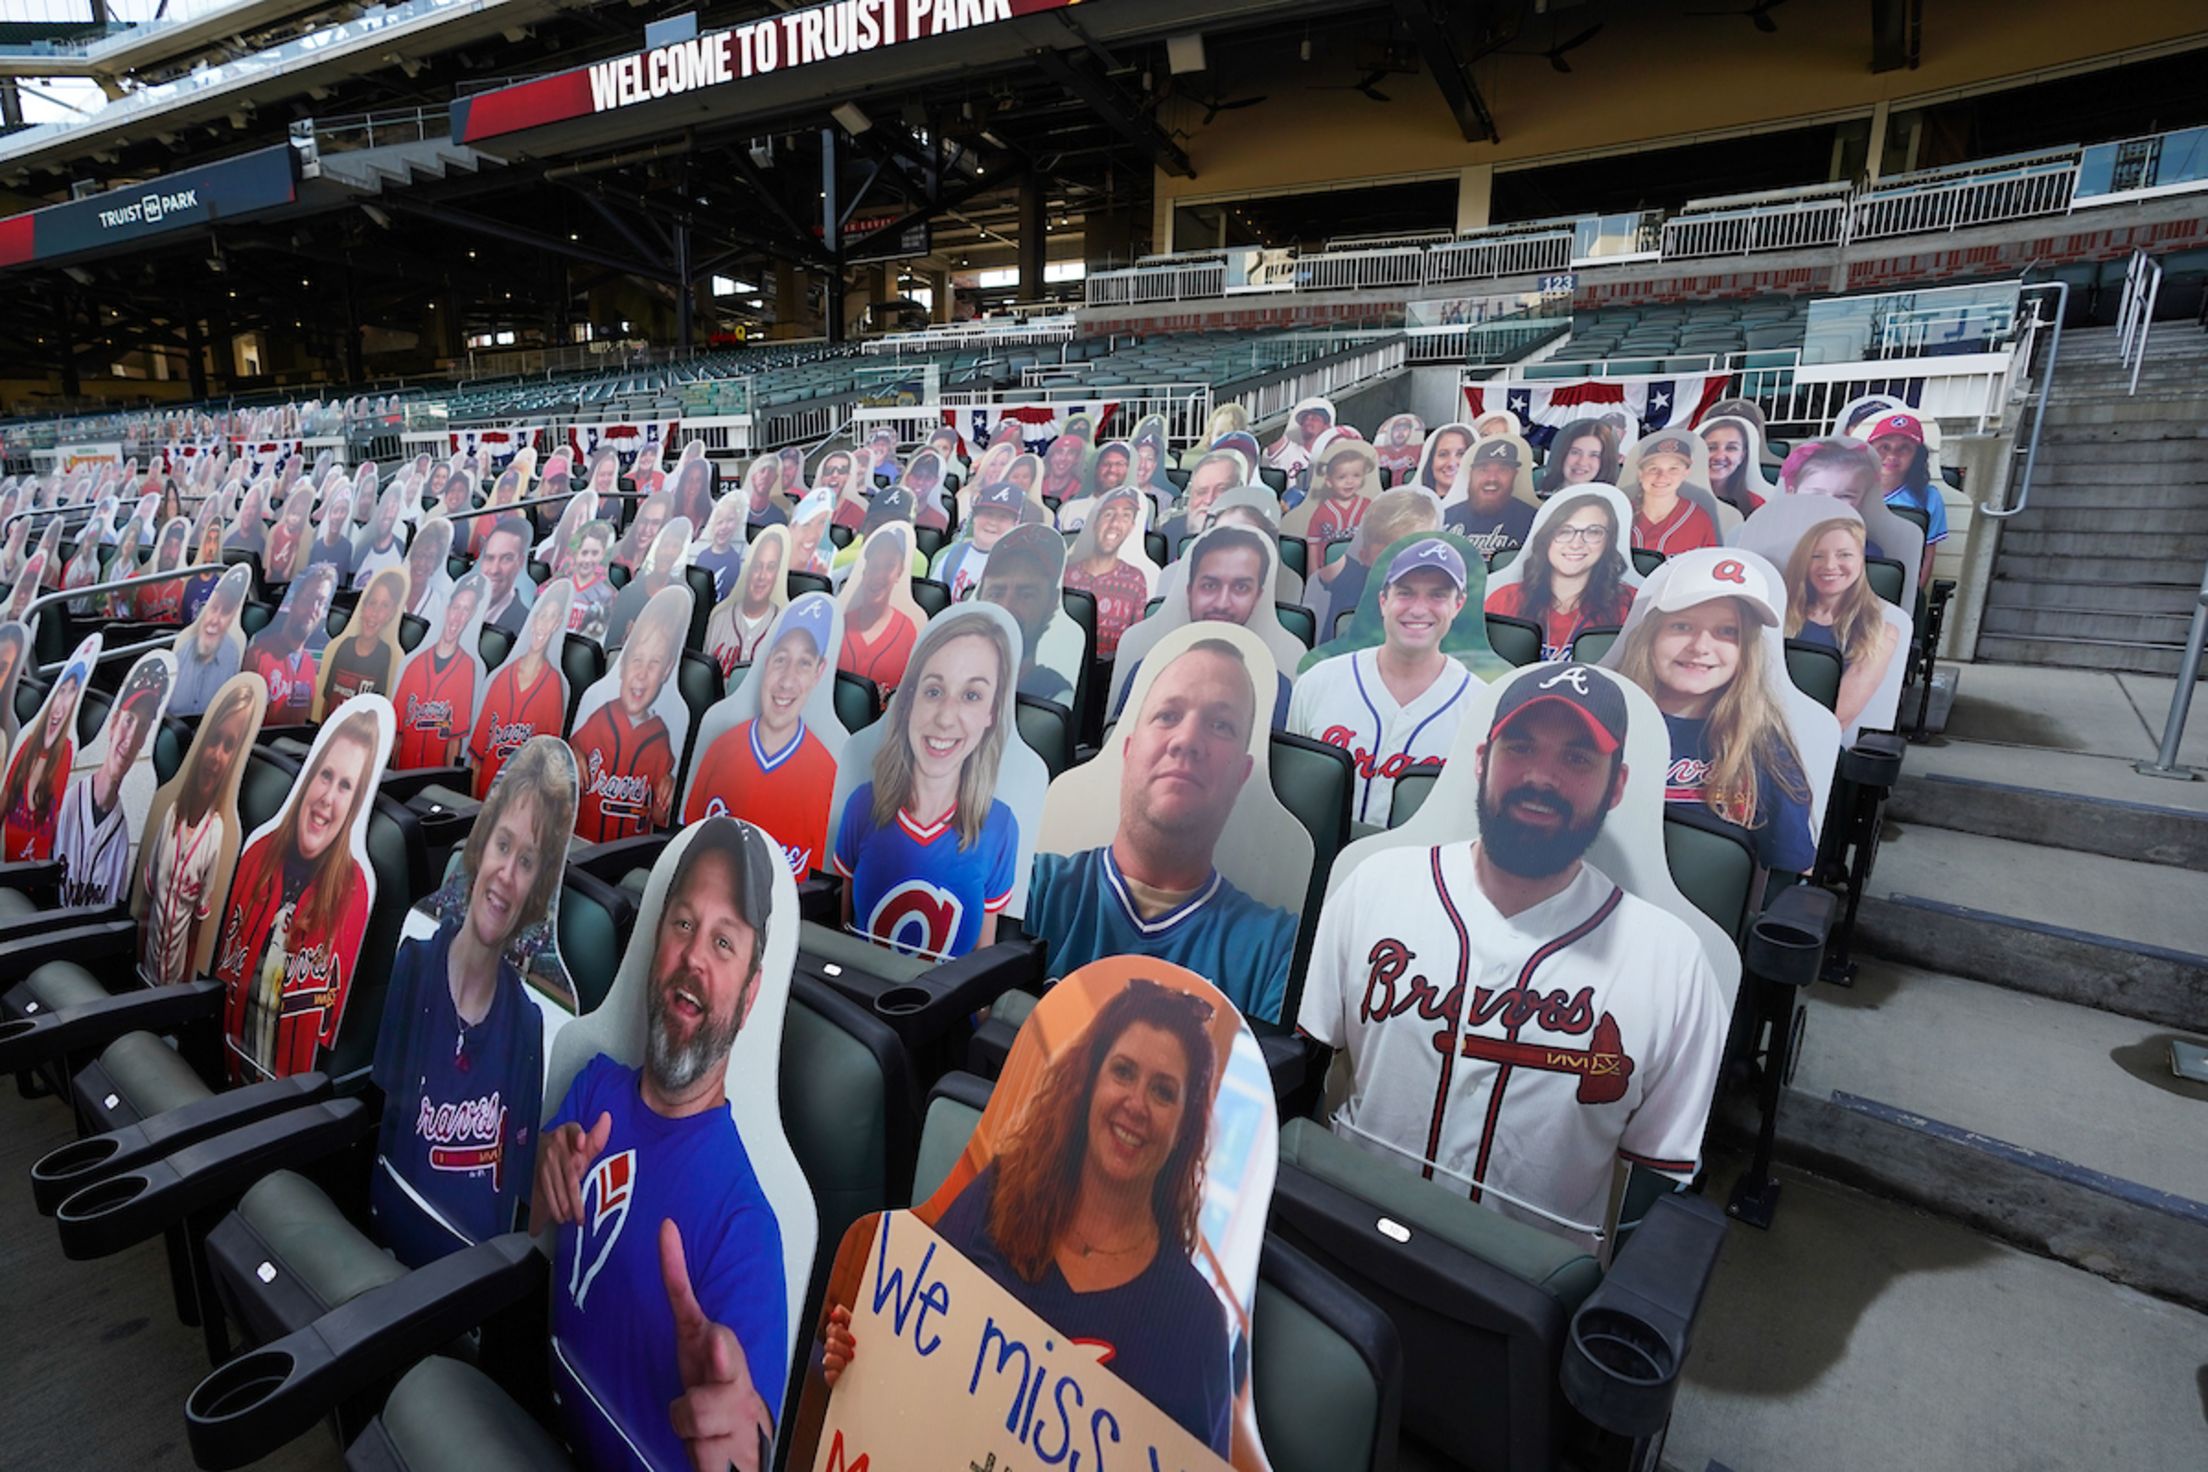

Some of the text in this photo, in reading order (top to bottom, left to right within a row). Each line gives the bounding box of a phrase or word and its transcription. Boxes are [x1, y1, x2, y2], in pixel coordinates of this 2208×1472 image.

[589, 29, 734, 112] WELCOME
[736, 20, 778, 78] TO
[782, 0, 902, 69] TRUIST
[99, 189, 198, 228] TRUIST PARK
[1544, 275, 1573, 291] 123
[1419, 543, 1448, 560] A
[798, 599, 822, 619] A
[1539, 667, 1589, 694] A
[1361, 938, 1595, 1035] Braves
[872, 1210, 950, 1357] We
